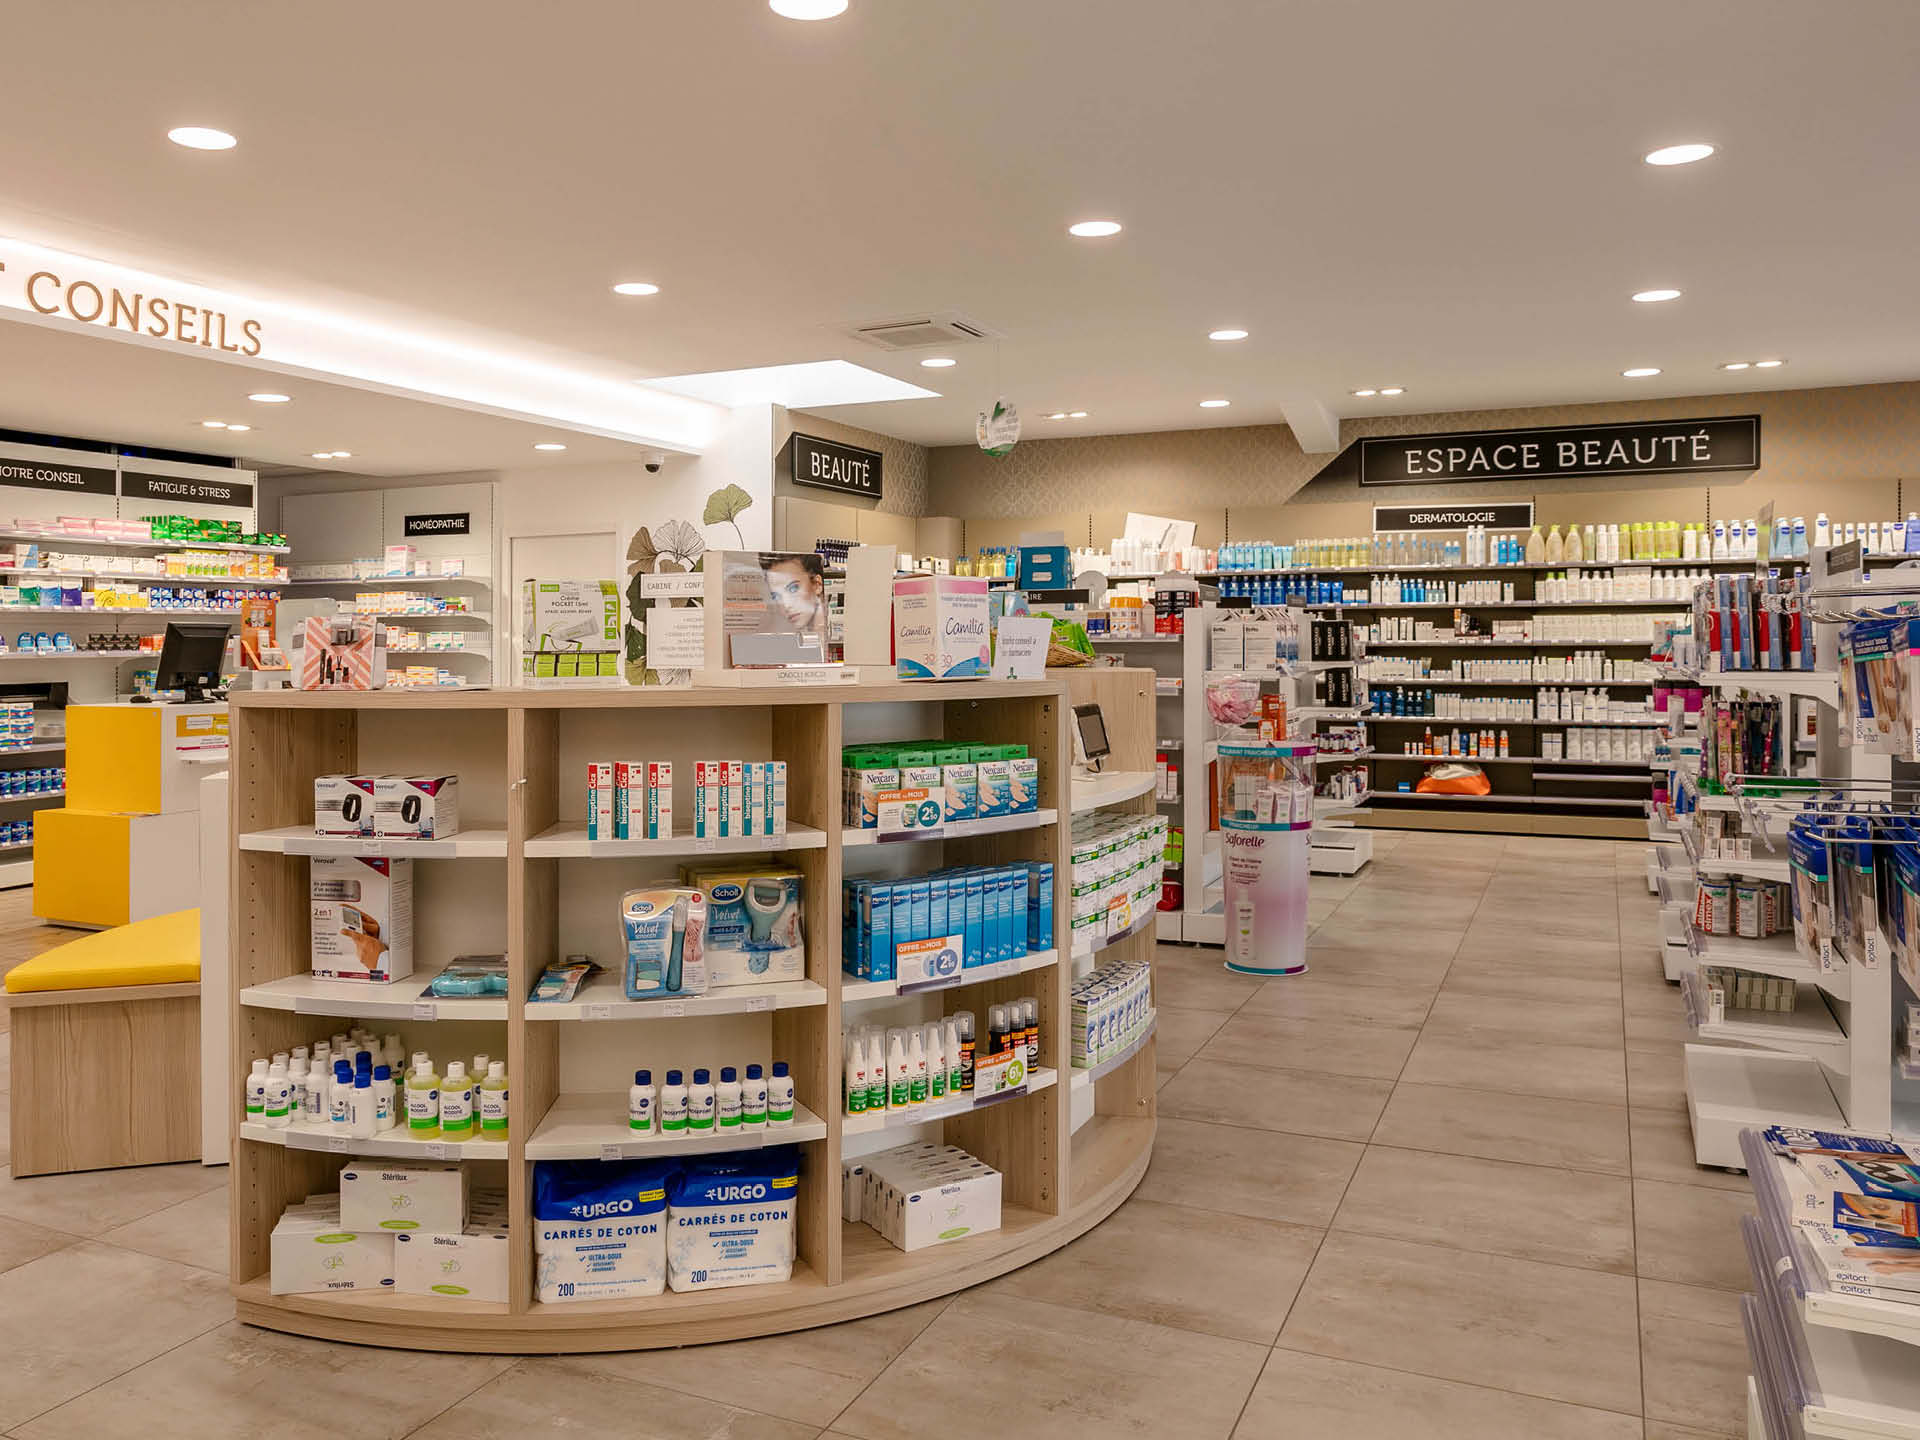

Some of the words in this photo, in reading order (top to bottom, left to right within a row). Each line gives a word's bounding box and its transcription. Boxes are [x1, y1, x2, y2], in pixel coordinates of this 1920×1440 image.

[26, 271, 262, 356] CONSEILS
[1405, 444, 1541, 474] ESPACE
[1556, 430, 1711, 468] BEAUTÉ
[811, 451, 871, 488] BEAUTÉ
[36, 469, 85, 486] CONSEIL
[148, 480, 189, 495] FATIGUE
[190, 485, 197, 495] &
[199, 486, 231, 500] STRESS
[409, 519, 465, 531] HOMÉOPATHIE
[1409, 512, 1496, 524] DERMATOLOGIE
[945, 616, 985, 635] Camilia
[948, 768, 974, 779] Nexcare
[982, 766, 1007, 776] Nexcare
[1012, 763, 1036, 773] Nexcare
[866, 773, 896, 785] Nexcare
[909, 771, 937, 782] Nexcare
[879, 793, 901, 801] OFFRE
[907, 790, 925, 798] MOIS
[1225, 832, 1265, 849] Saforelle
[714, 887, 740, 899] Scholl
[1704, 900, 1712, 931] elmex
[1823, 943, 1832, 969] epitact
[1867, 936, 1876, 964] epitact
[382, 1172, 407, 1181] Stérilux
[717, 1184, 766, 1201] URGO
[583, 1200, 633, 1218] URGO
[679, 1213, 726, 1227] CARRÉS
[730, 1214, 745, 1223] DE
[750, 1211, 788, 1222] COTON
[544, 1228, 592, 1240] CARRÉS
[597, 1228, 613, 1237] DE
[618, 1224, 657, 1236] COTON
[434, 1236, 458, 1246] Stérilux
[691, 1270, 707, 1283] 200
[1836, 1273, 1868, 1282] epitact
[558, 1283, 574, 1297] 200
[1840, 1285, 1872, 1295] epitact
